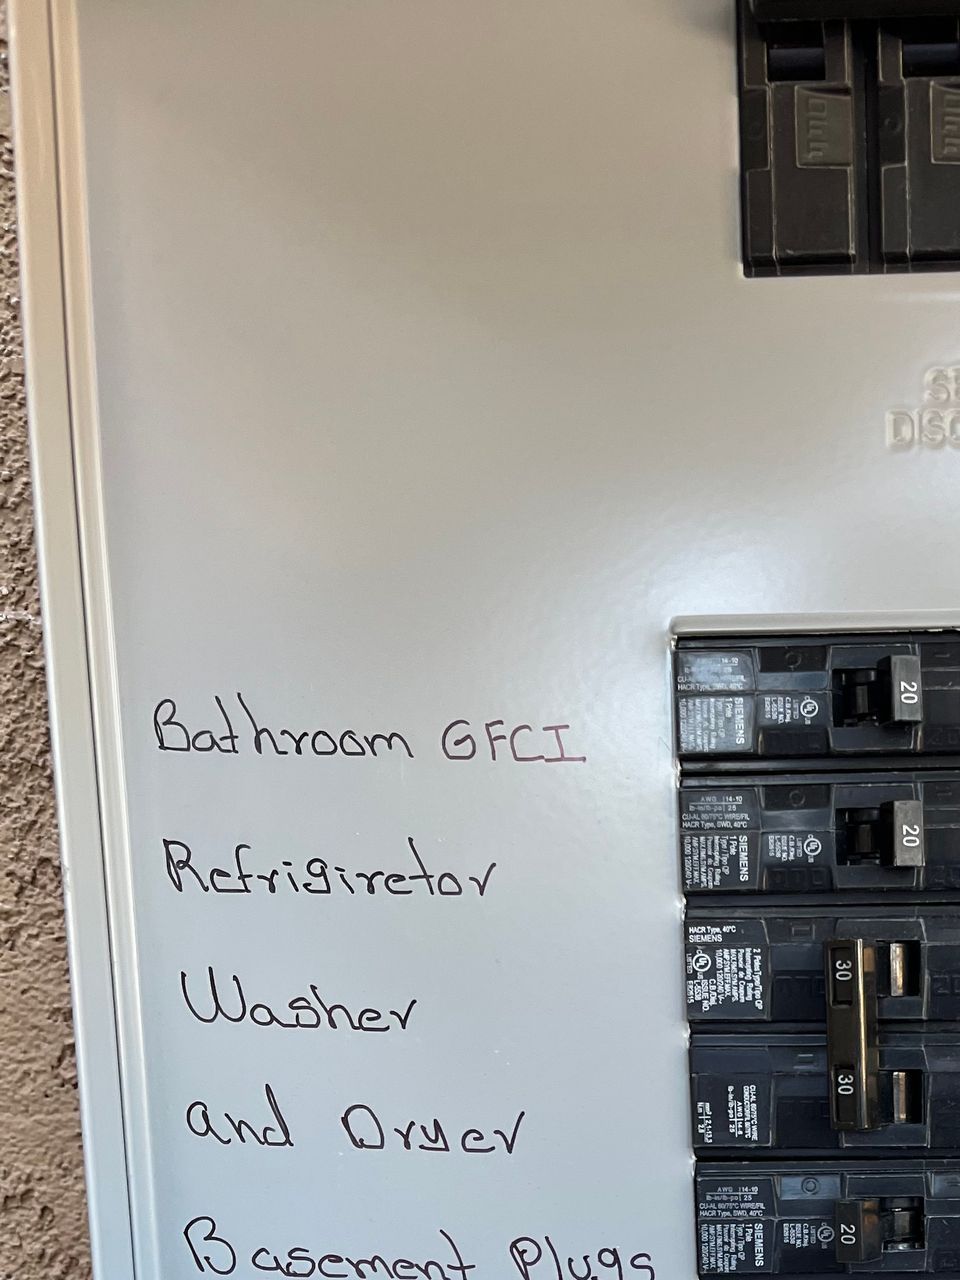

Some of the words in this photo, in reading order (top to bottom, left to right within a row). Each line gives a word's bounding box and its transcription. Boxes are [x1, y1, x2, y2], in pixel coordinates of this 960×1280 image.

[900, 681, 917, 704] 20
[153, 692, 414, 757] Bathroom
[441, 719, 586, 763] GFCI
[902, 825, 920, 847] 20
[739, 836, 748, 881] SIEMENS
[689, 934, 722, 942] SIEMENS
[836, 960, 851, 980] 30
[180, 967, 417, 1032] Washer
[838, 1074, 854, 1095] 30
[341, 1104, 525, 1155] Dryer
[755, 1223, 763, 1267] SIEMENS
[840, 1224, 856, 1245] 20
